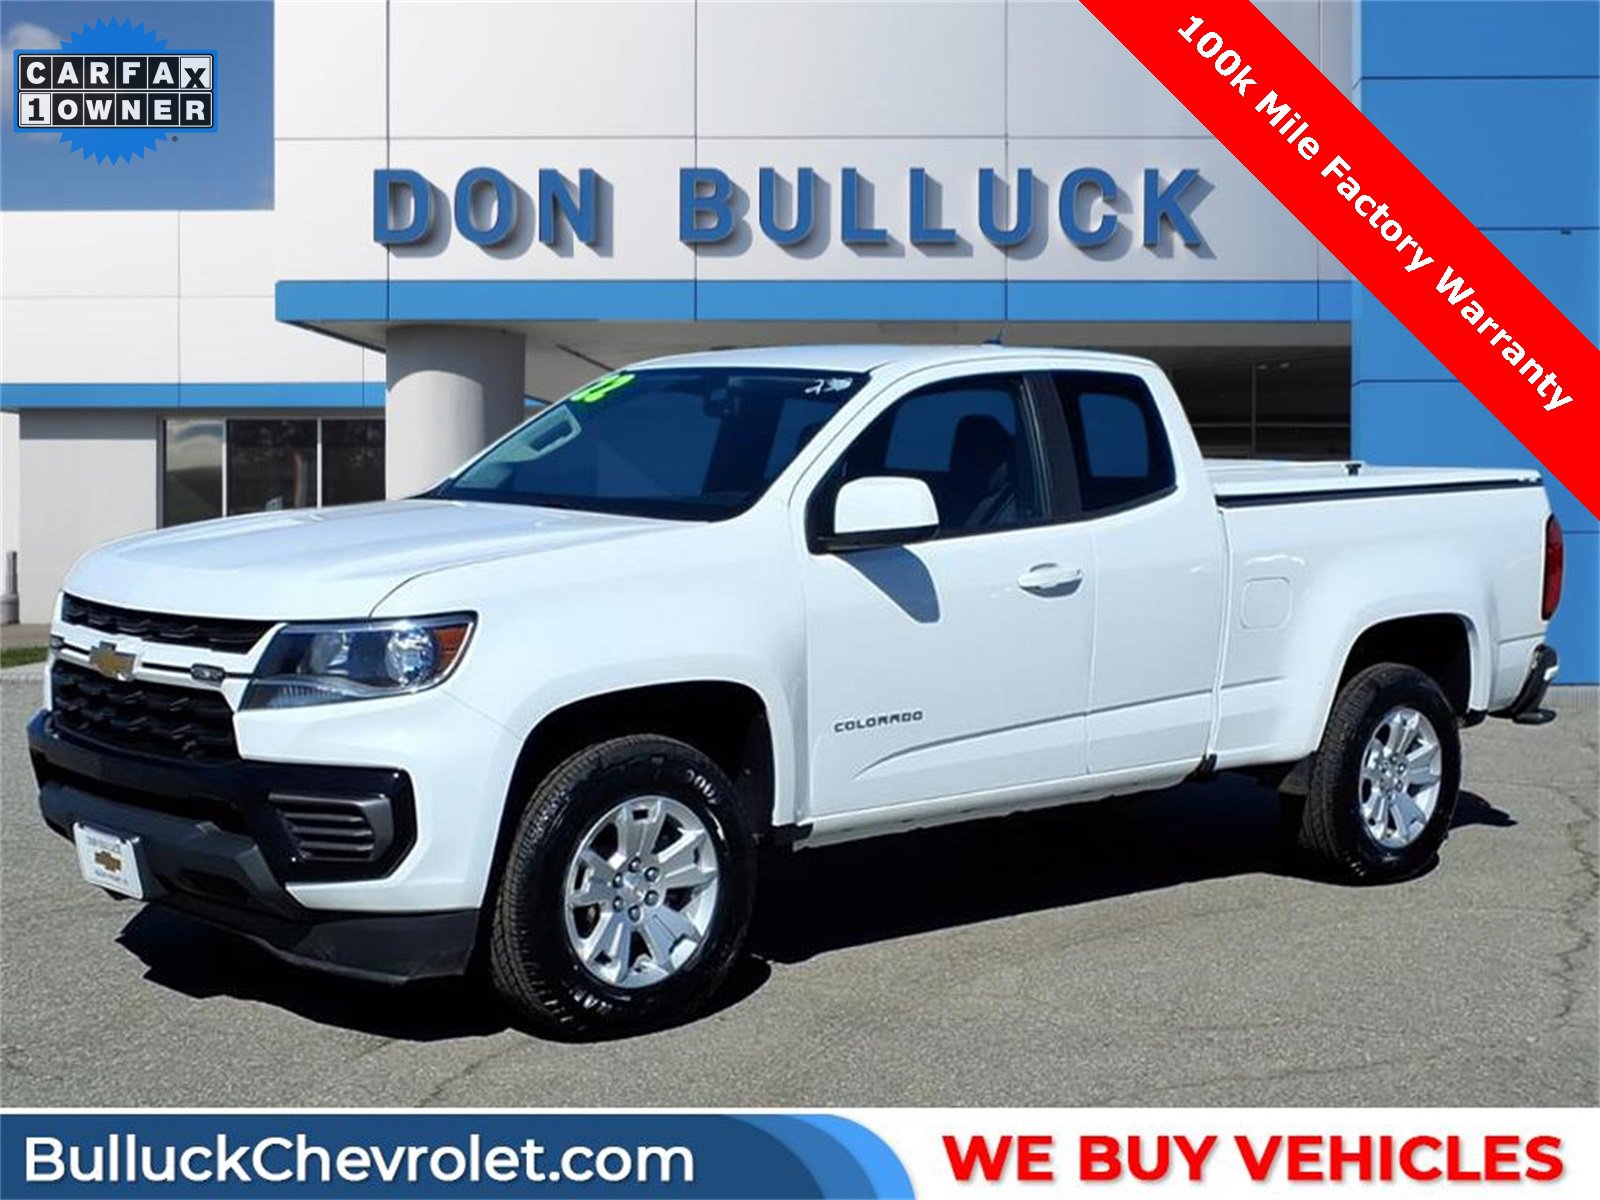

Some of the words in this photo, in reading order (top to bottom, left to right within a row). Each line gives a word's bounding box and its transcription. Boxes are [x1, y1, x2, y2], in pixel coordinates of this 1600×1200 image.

[373, 168, 598, 247] DON
[680, 168, 1202, 248] BULLUCK
[834, 710, 923, 732] COLORADO
